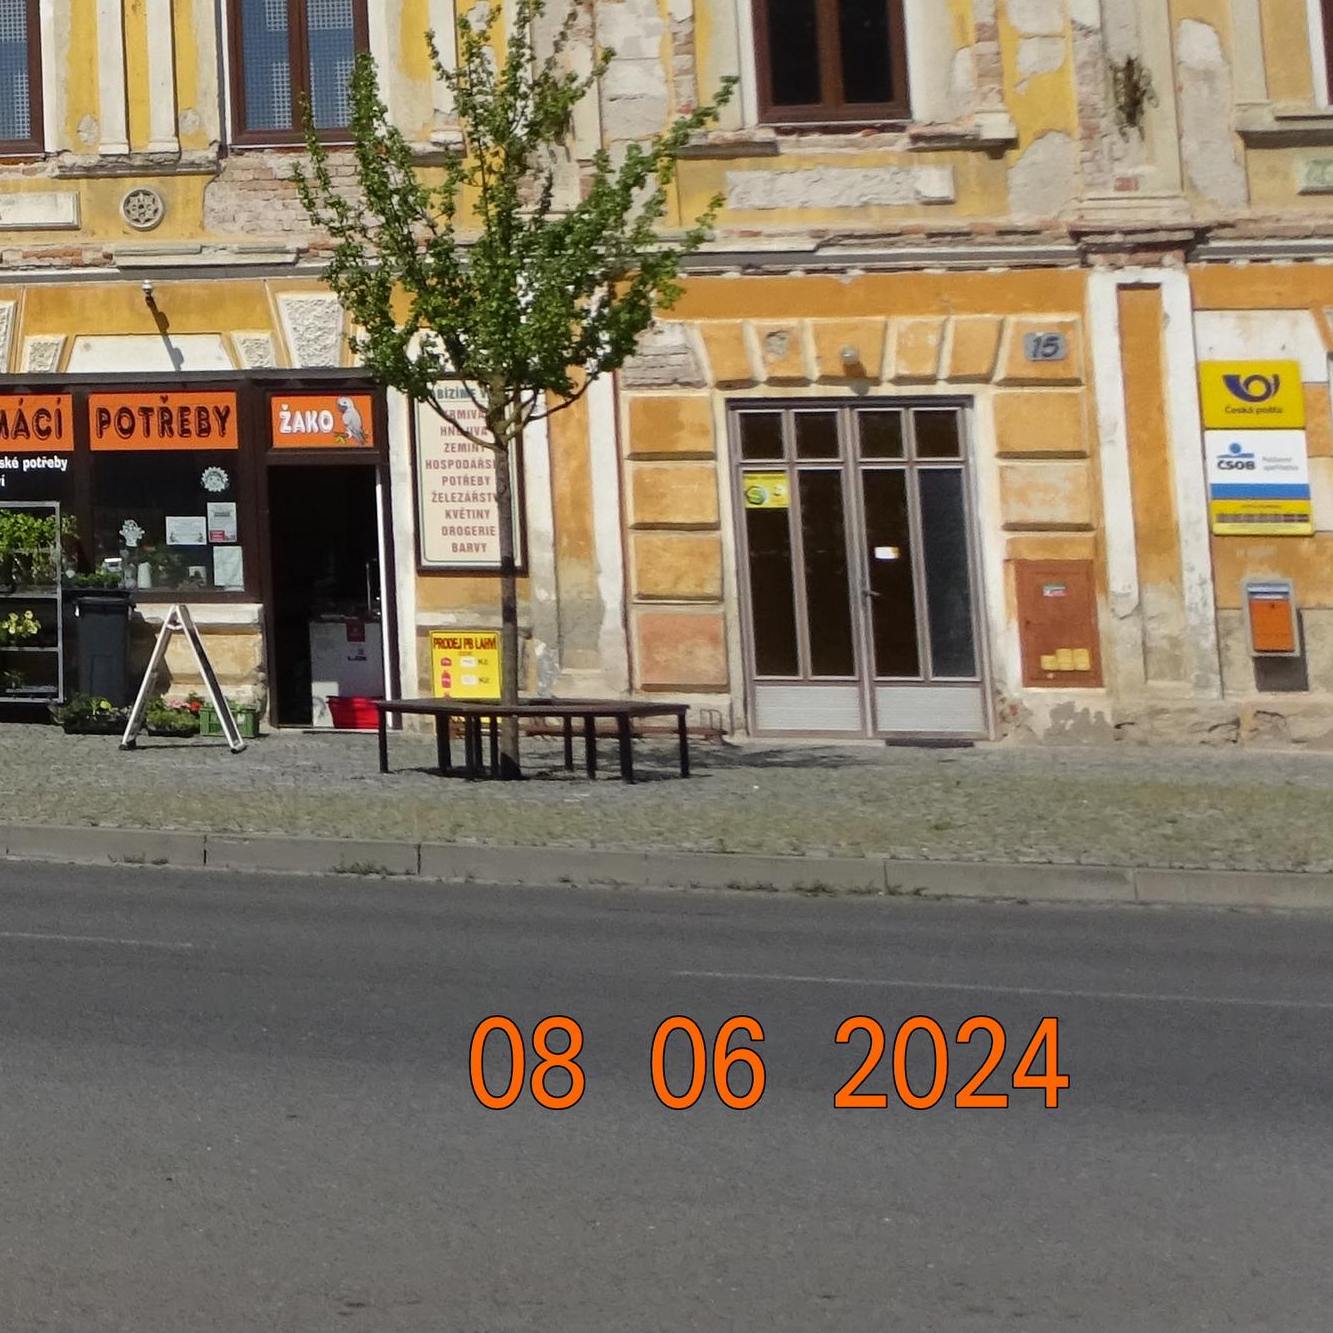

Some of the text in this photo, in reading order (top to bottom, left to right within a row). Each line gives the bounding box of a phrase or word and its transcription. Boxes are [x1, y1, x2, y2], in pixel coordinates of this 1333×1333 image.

[1032, 336, 1060, 358] 15
[95, 394, 231, 440] POTŘEBY
[278, 403, 334, 434] ŽAKO
[22, 455, 69, 472] potřeby
[441, 474, 491, 486] POTŘEBY
[445, 507, 490, 520] KVĚTINY
[441, 525, 496, 537] DROGERIE
[451, 542, 487, 553] BARVY
[433, 637, 462, 650] PRODEJ
